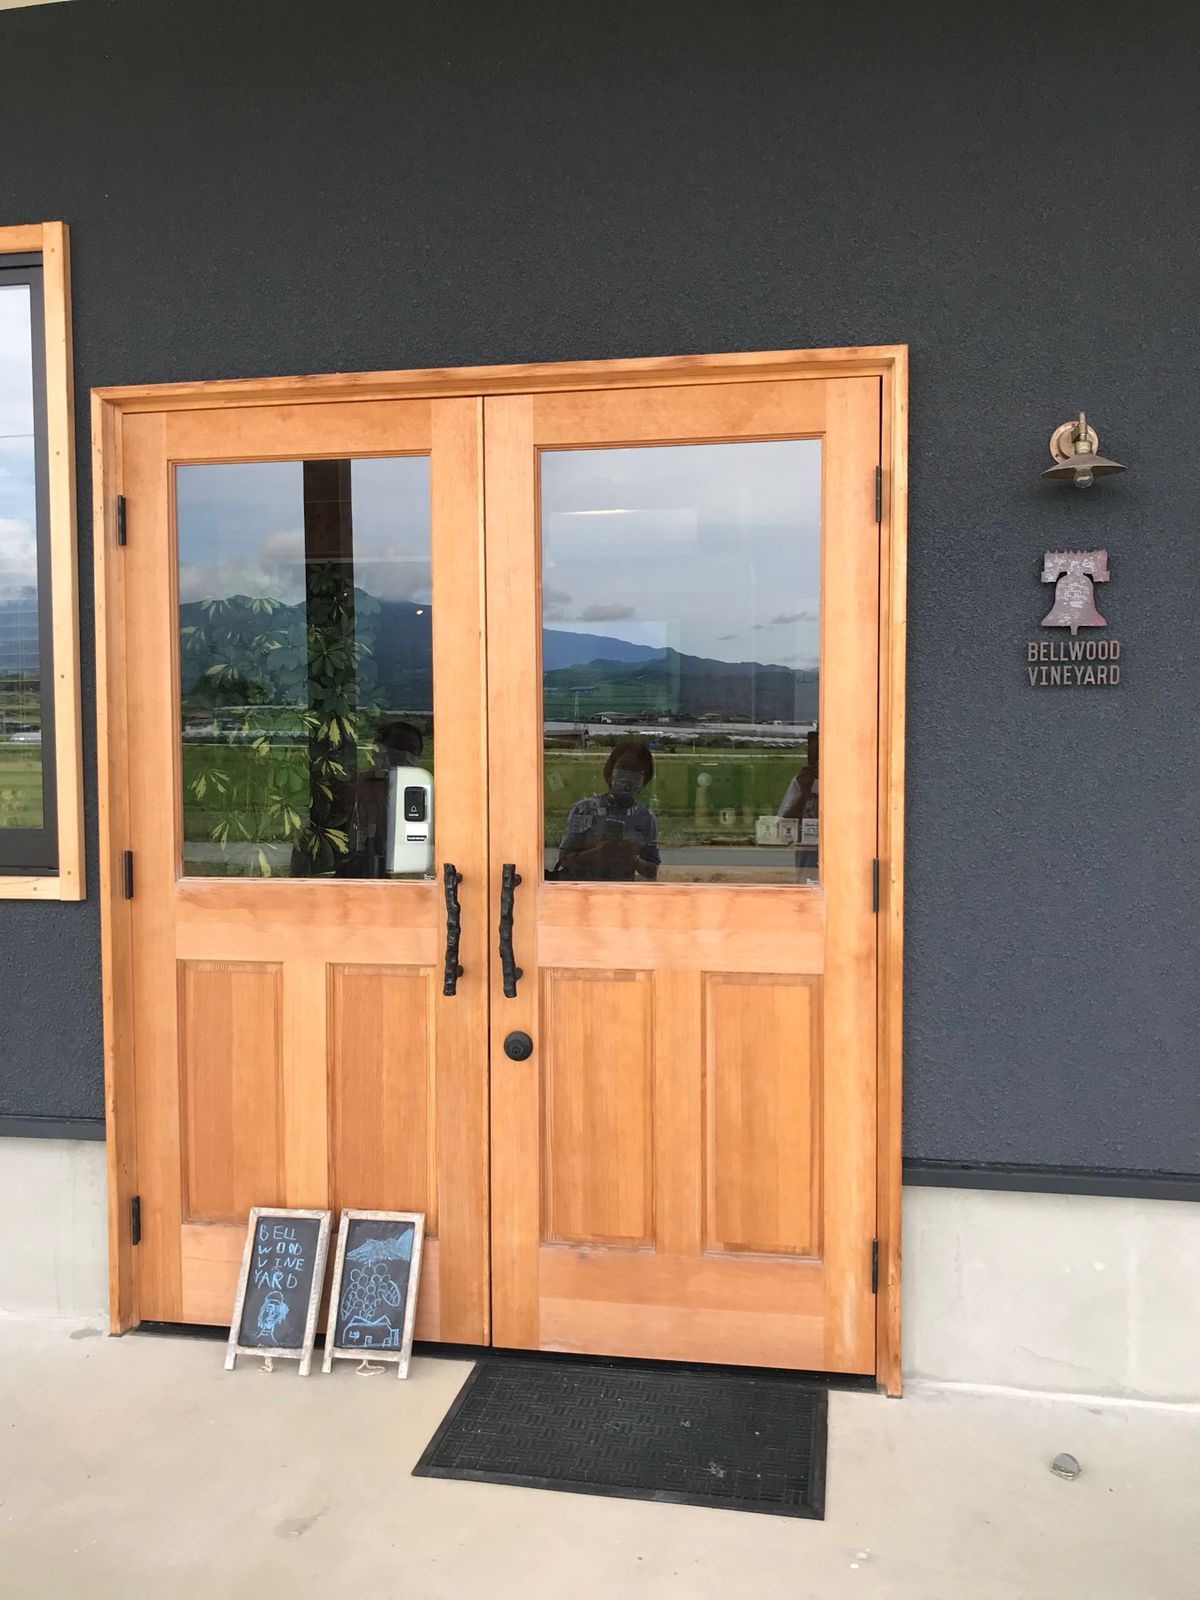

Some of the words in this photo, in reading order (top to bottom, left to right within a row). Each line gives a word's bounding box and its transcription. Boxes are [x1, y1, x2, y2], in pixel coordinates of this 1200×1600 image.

[1027, 640, 1121, 662] BELLWOOD
[1027, 665, 1121, 686] VINEYARD
[259, 1223, 297, 1241] BELL
[257, 1256, 305, 1271] VINE
[254, 1269, 298, 1290] YARD
